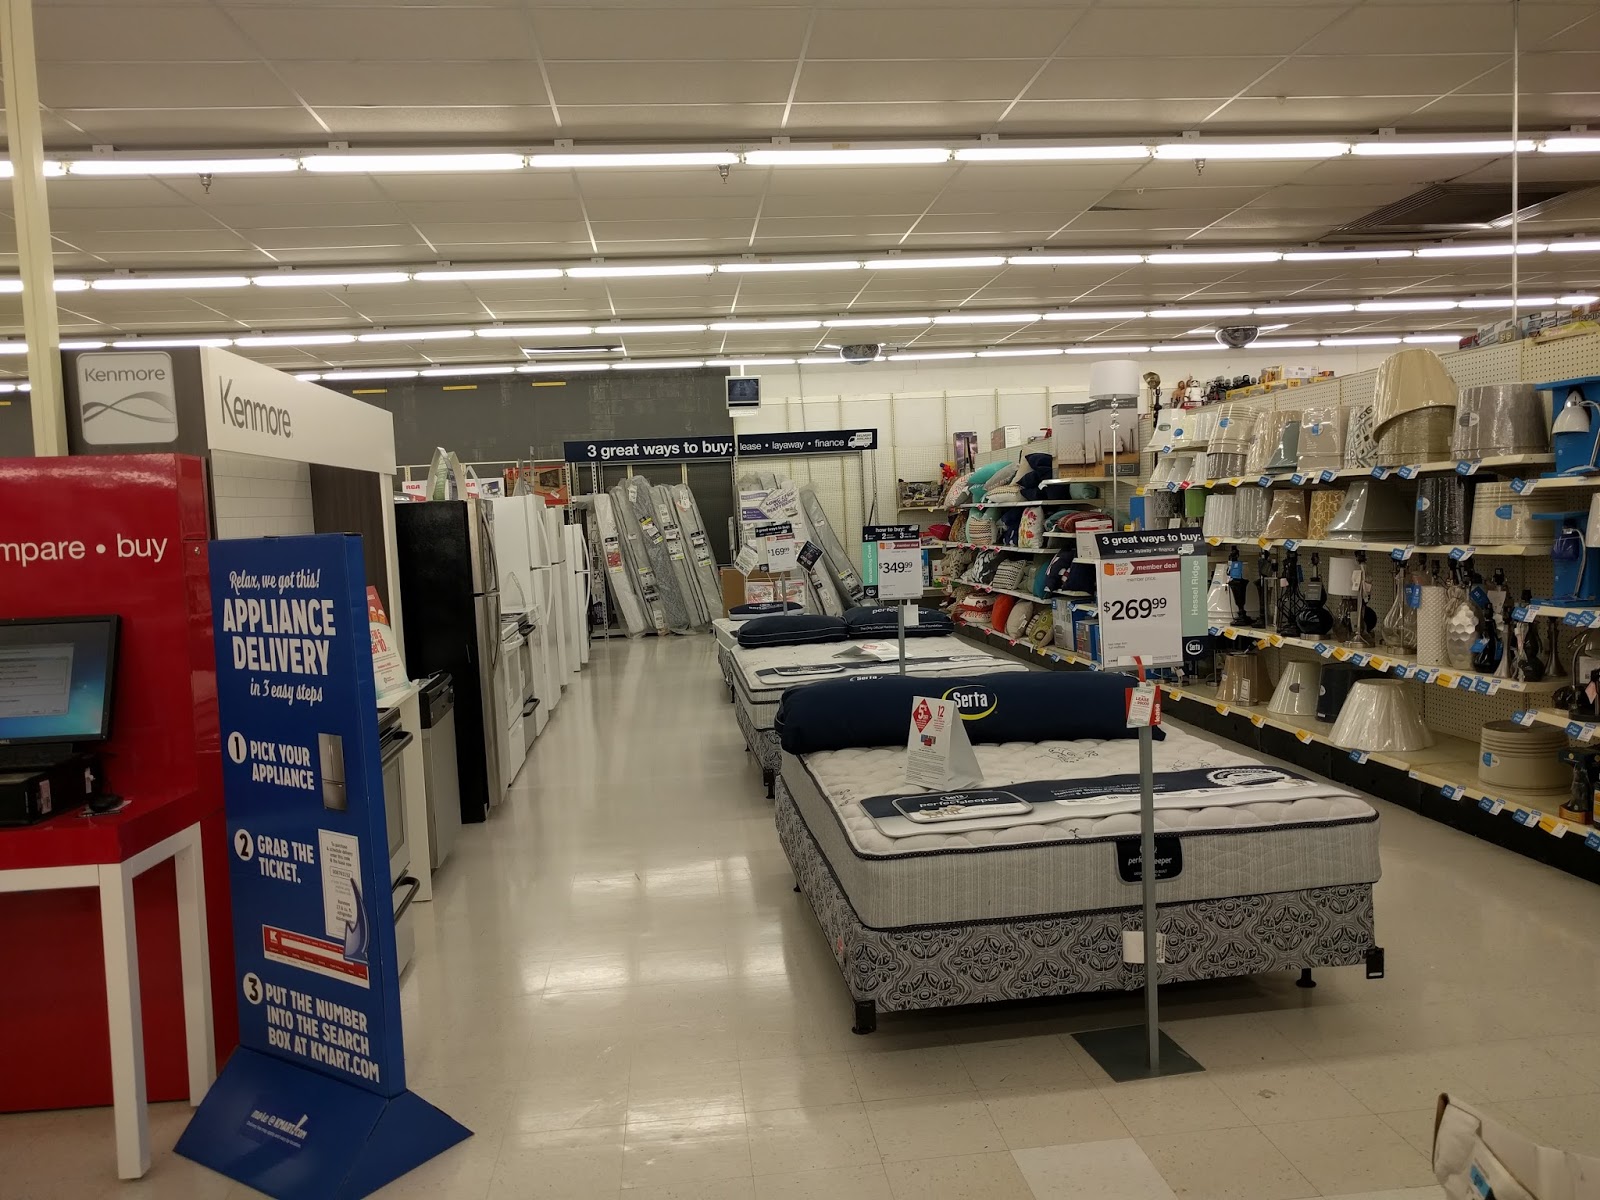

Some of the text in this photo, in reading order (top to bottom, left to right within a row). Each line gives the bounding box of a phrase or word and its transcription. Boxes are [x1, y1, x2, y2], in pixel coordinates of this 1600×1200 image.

[84, 366, 166, 382] Kenmore
[218, 375, 292, 438] Kenmore
[587, 441, 732, 459] 3 great ways to buy:
[772, 441, 804, 450] layaway
[815, 439, 844, 447] finance
[117, 533, 167, 563] buy
[1112, 535, 1138, 546] great
[1140, 534, 1166, 544] ways
[1167, 533, 1178, 542] to
[229, 569, 320, 595] Relax, we got this!
[1192, 560, 1200, 584] Ridge
[223, 599, 336, 636] APPLIANCE
[232, 636, 329, 675] DELIVERY
[250, 678, 323, 707] in 3 easy steps
[953, 692, 988, 707] Serta
[938, 706, 944, 717] 12
[234, 737, 240, 759] 1
[250, 740, 310, 767] PICK YOUR
[252, 763, 314, 790] APPLIANCE
[239, 833, 249, 857] 2
[257, 835, 314, 864] GRAB THE
[258, 857, 301, 883] TICKET.
[248, 977, 258, 1001] 3
[265, 983, 368, 1033] PUT THE NUMBER
[267, 1005, 370, 1057] INTO THE SEARCH
[268, 1026, 380, 1083] BOX AT KMART.COM
